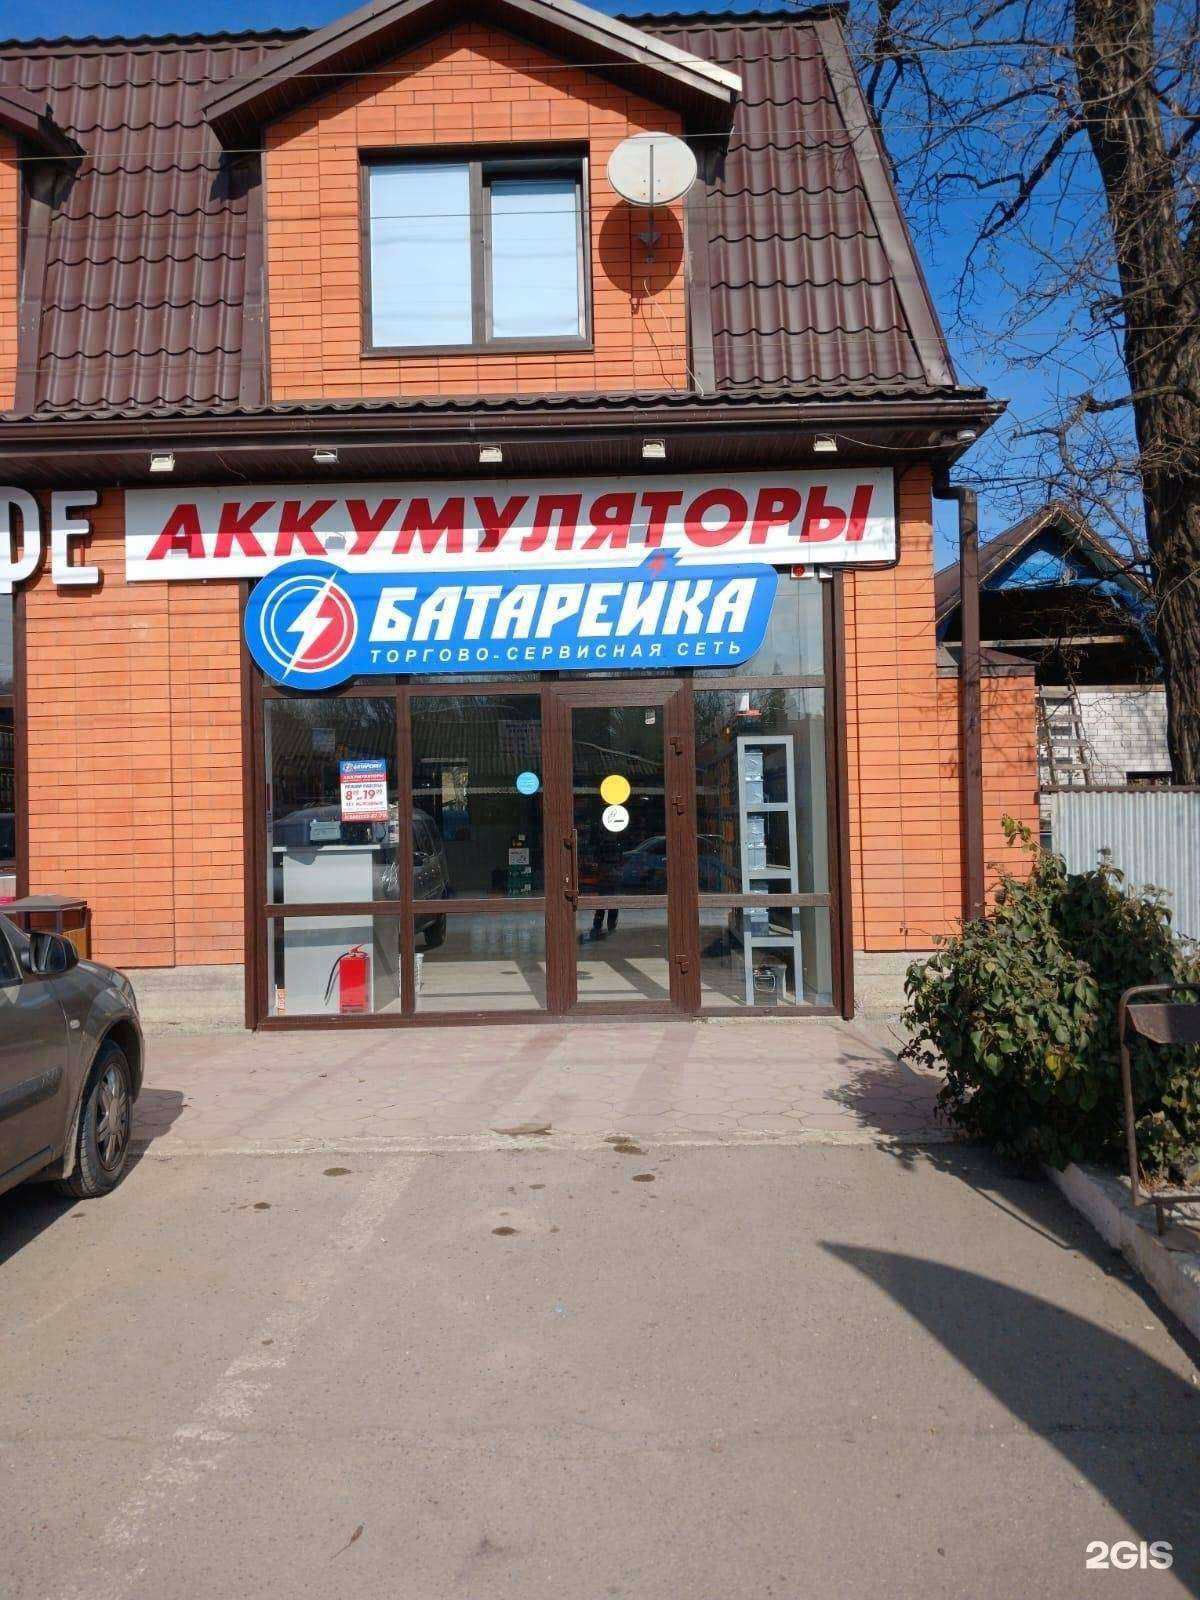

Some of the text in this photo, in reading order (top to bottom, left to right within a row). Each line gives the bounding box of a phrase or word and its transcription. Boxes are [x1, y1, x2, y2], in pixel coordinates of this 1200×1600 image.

[145, 484, 874, 560] АККУМУЛЯТОРЫ
[370, 641, 741, 664] ТОРГОВО-СЕРВИСНАЯ СЕТЬ
